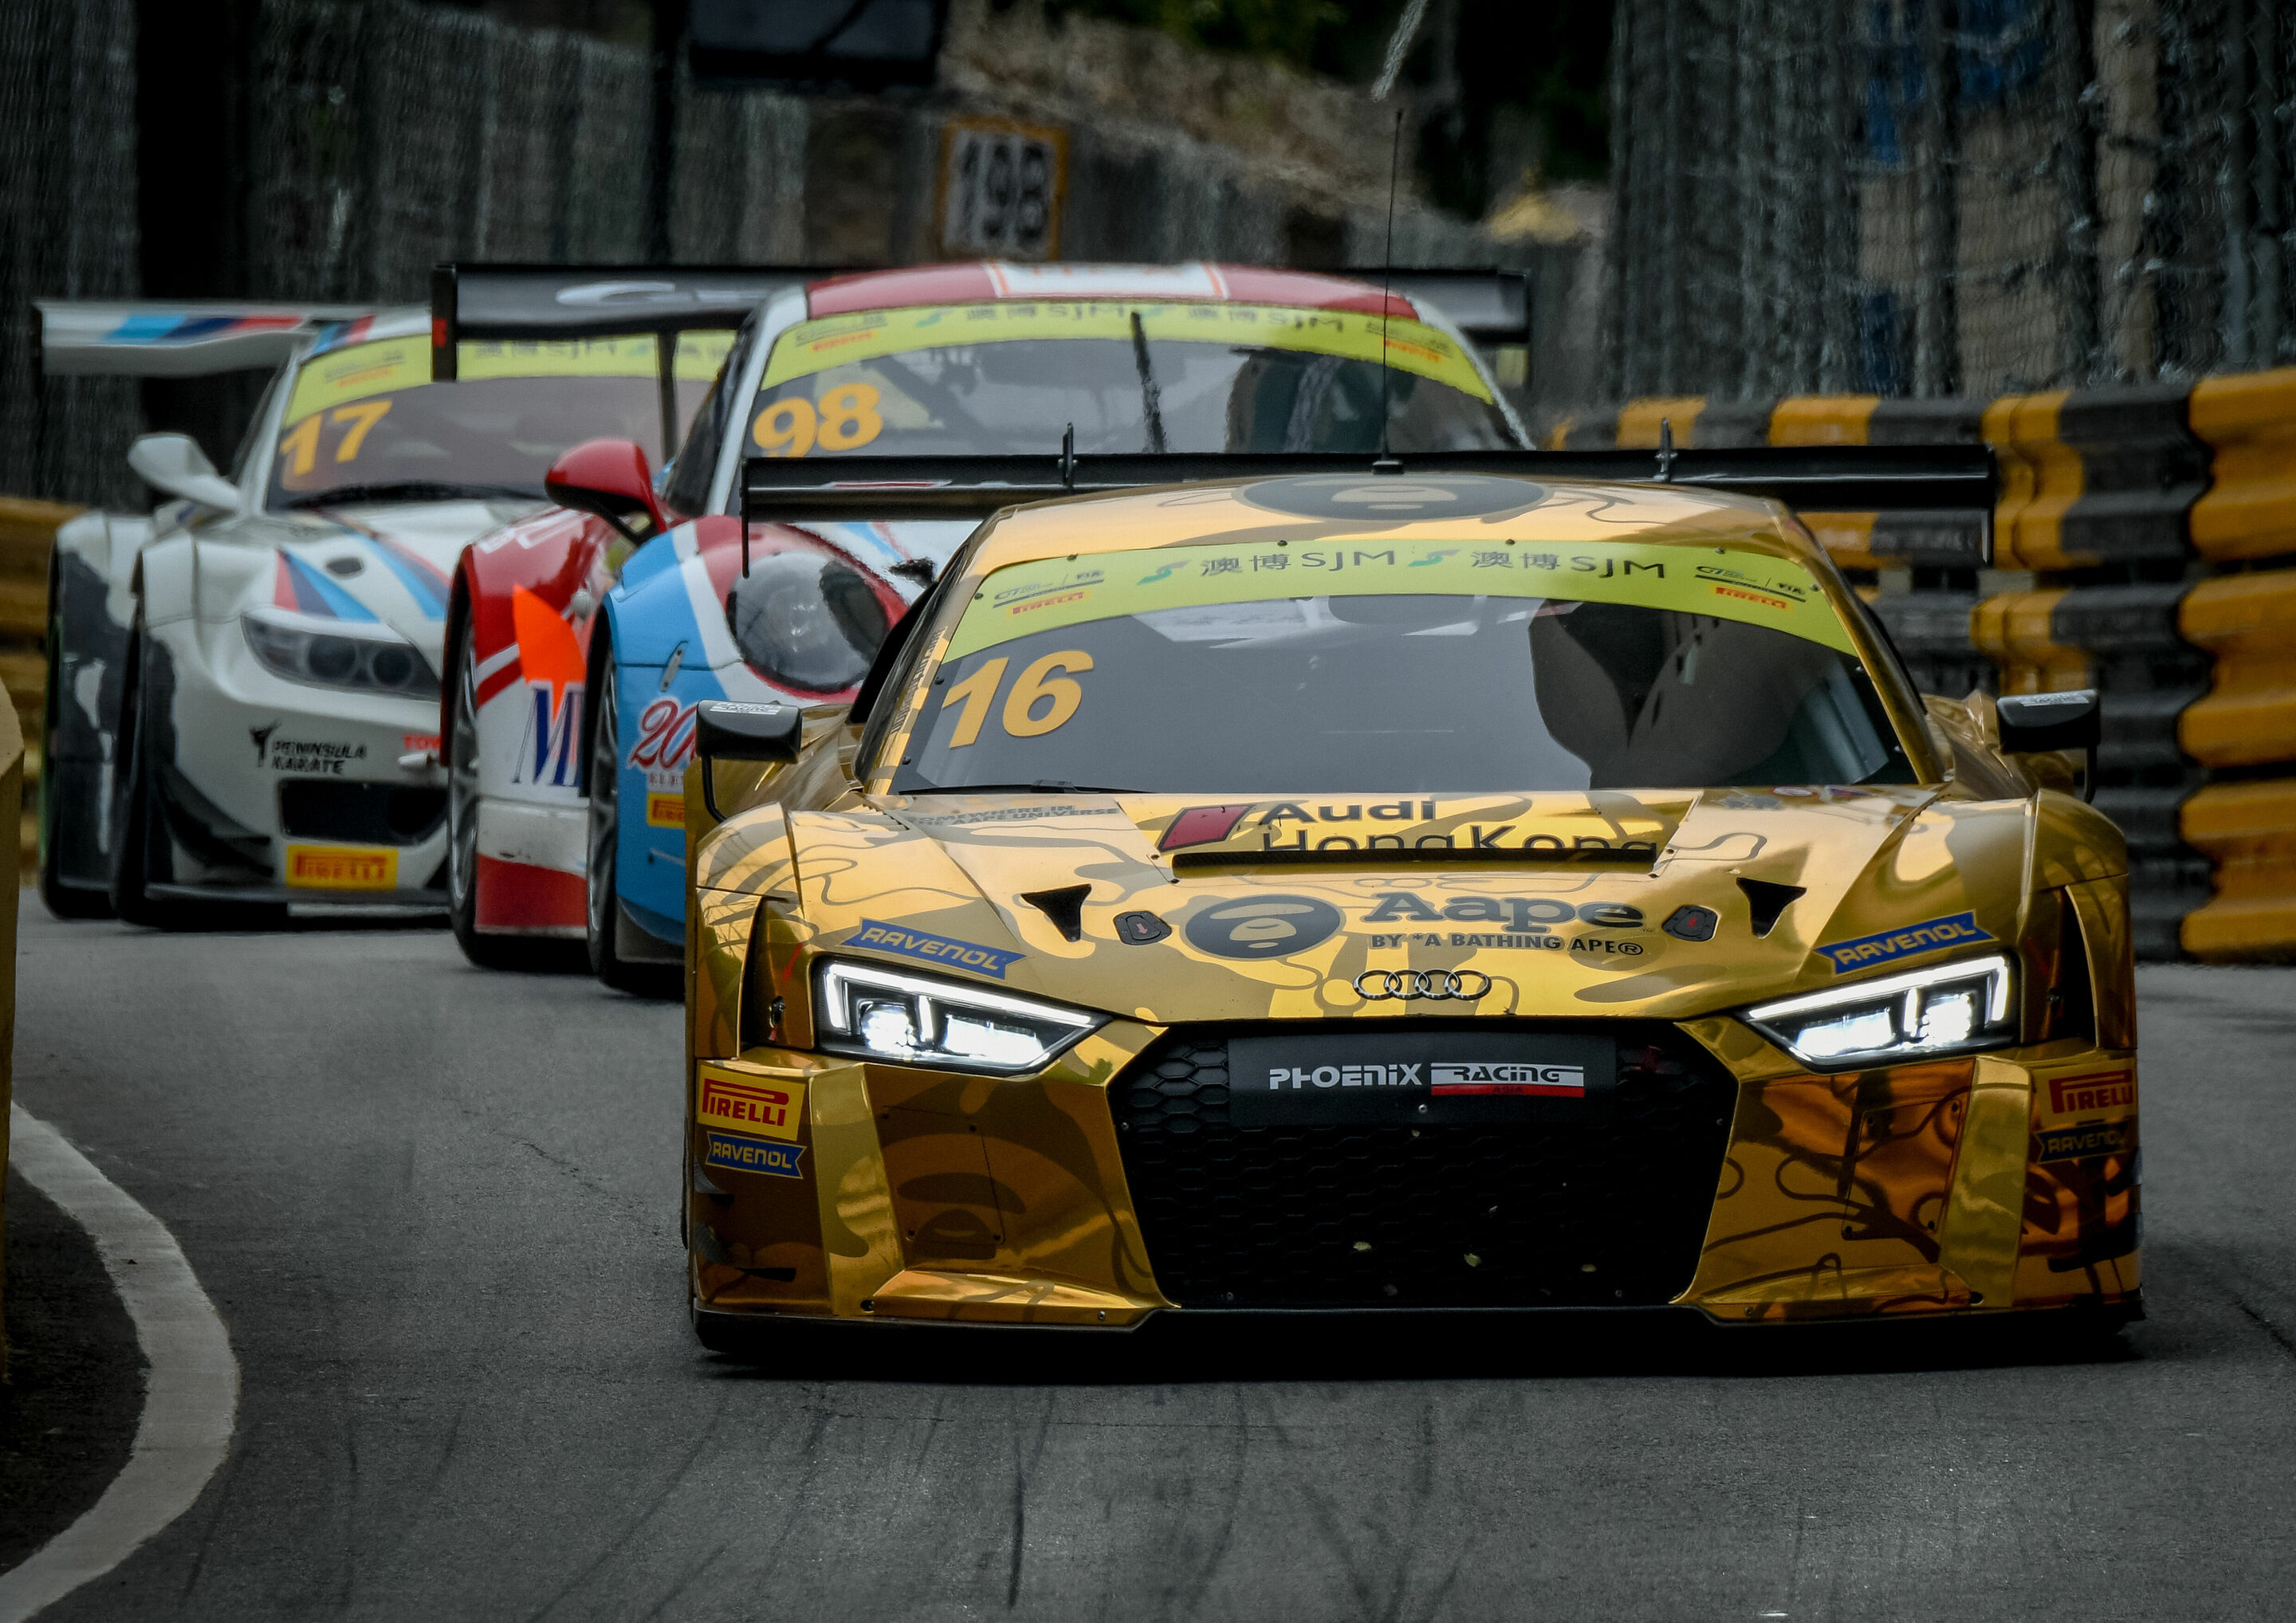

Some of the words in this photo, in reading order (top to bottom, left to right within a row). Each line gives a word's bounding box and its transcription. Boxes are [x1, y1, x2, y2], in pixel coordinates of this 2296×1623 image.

[280, 399, 394, 476] 17
[753, 383, 883, 458] 98
[942, 650, 1095, 749] 16
[272, 741, 368, 760] PENINSULA
[630, 700, 697, 768] 20
[271, 756, 345, 776] KARATE
[1012, 808, 1119, 819] UNIVERSE
[1260, 800, 1437, 824] Audi
[1358, 891, 1645, 936] Aape
[859, 925, 1004, 972] RAVENOL
[1371, 933, 1399, 950] BY
[1452, 932, 1563, 951] BATHING
[1834, 921, 1978, 965] RAVENOL
[702, 1078, 789, 1127] PIRELLI
[2049, 1068, 2134, 1114] PIRELLI
[712, 1141, 792, 1169] RAVENOL
